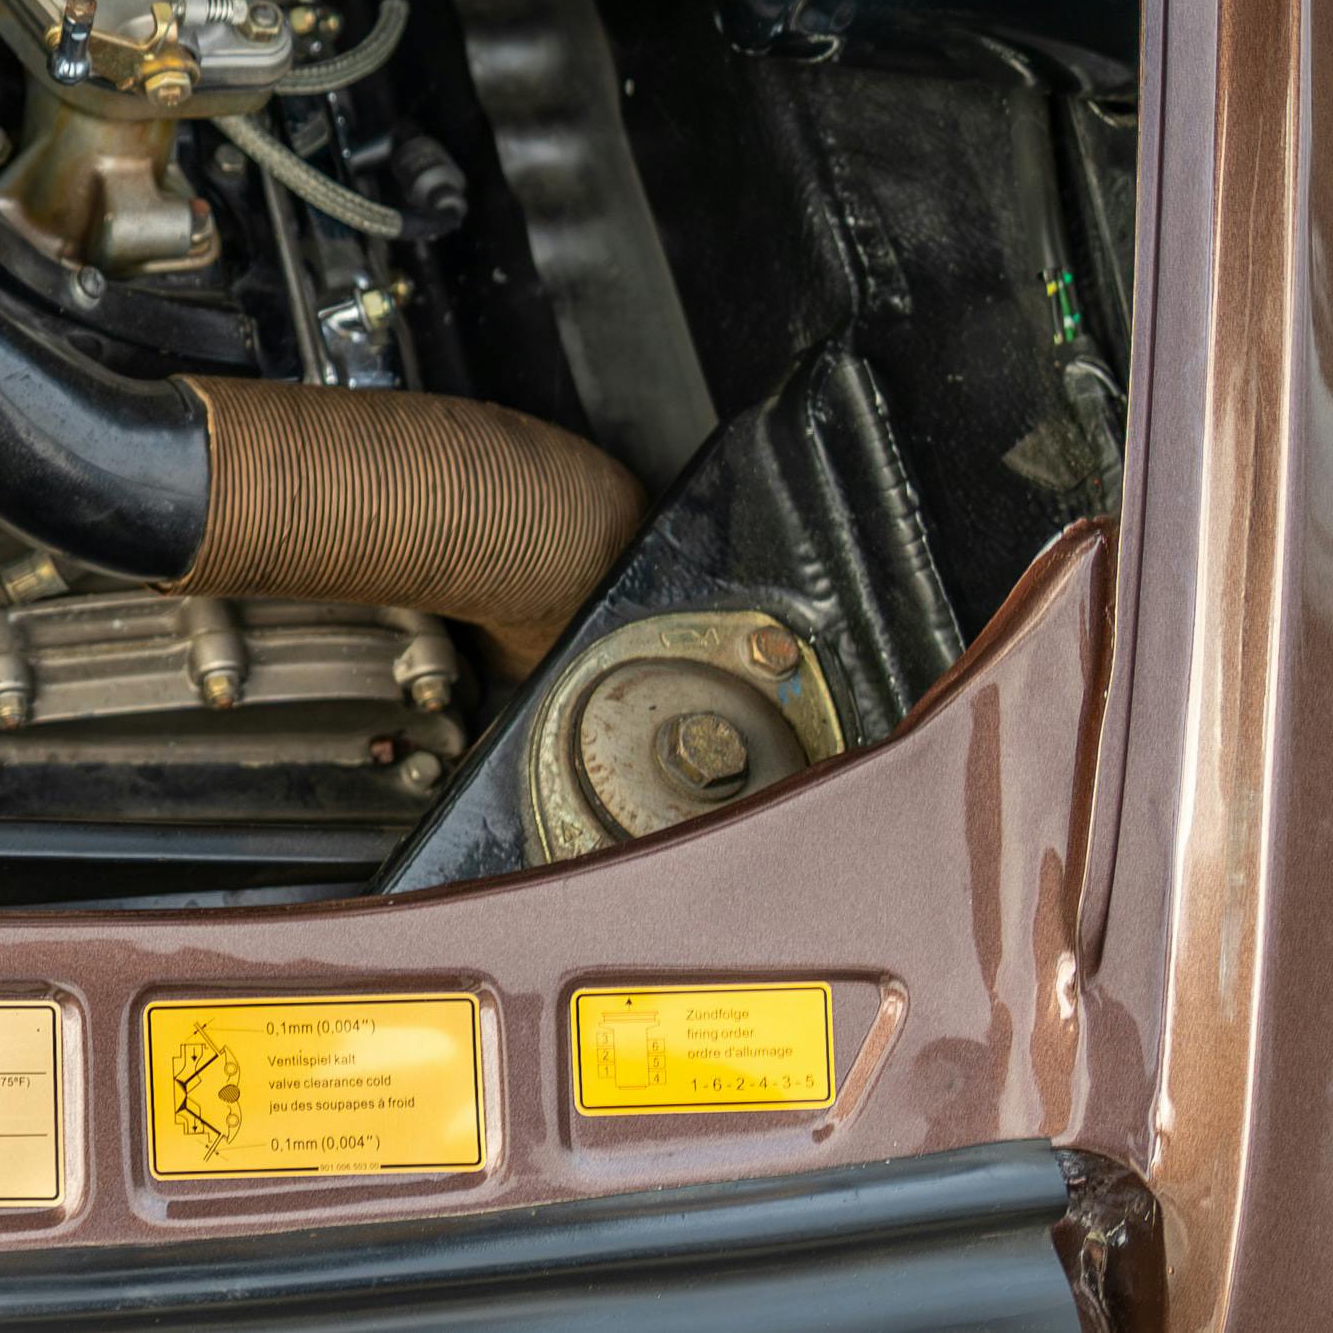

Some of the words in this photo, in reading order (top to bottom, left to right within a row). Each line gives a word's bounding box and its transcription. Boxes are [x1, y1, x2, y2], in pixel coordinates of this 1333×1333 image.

[687, 1028, 718, 1040] firing
[721, 1028, 754, 1038] order
[688, 1048, 720, 1059] ordre
[724, 1046, 792, 1059] d'allumage
[268, 1055, 331, 1067] Ventilspiel
[334, 1054, 355, 1065] kalt
[268, 1077, 301, 1089] valve
[304, 1076, 363, 1089] clearance
[366, 1075, 391, 1087] cold
[269, 1098, 288, 1113] jeu
[291, 1098, 312, 1111] des
[317, 1098, 374, 1113] soupapes
[378, 1097, 385, 1109] à
[388, 1097, 415, 1109] froid
